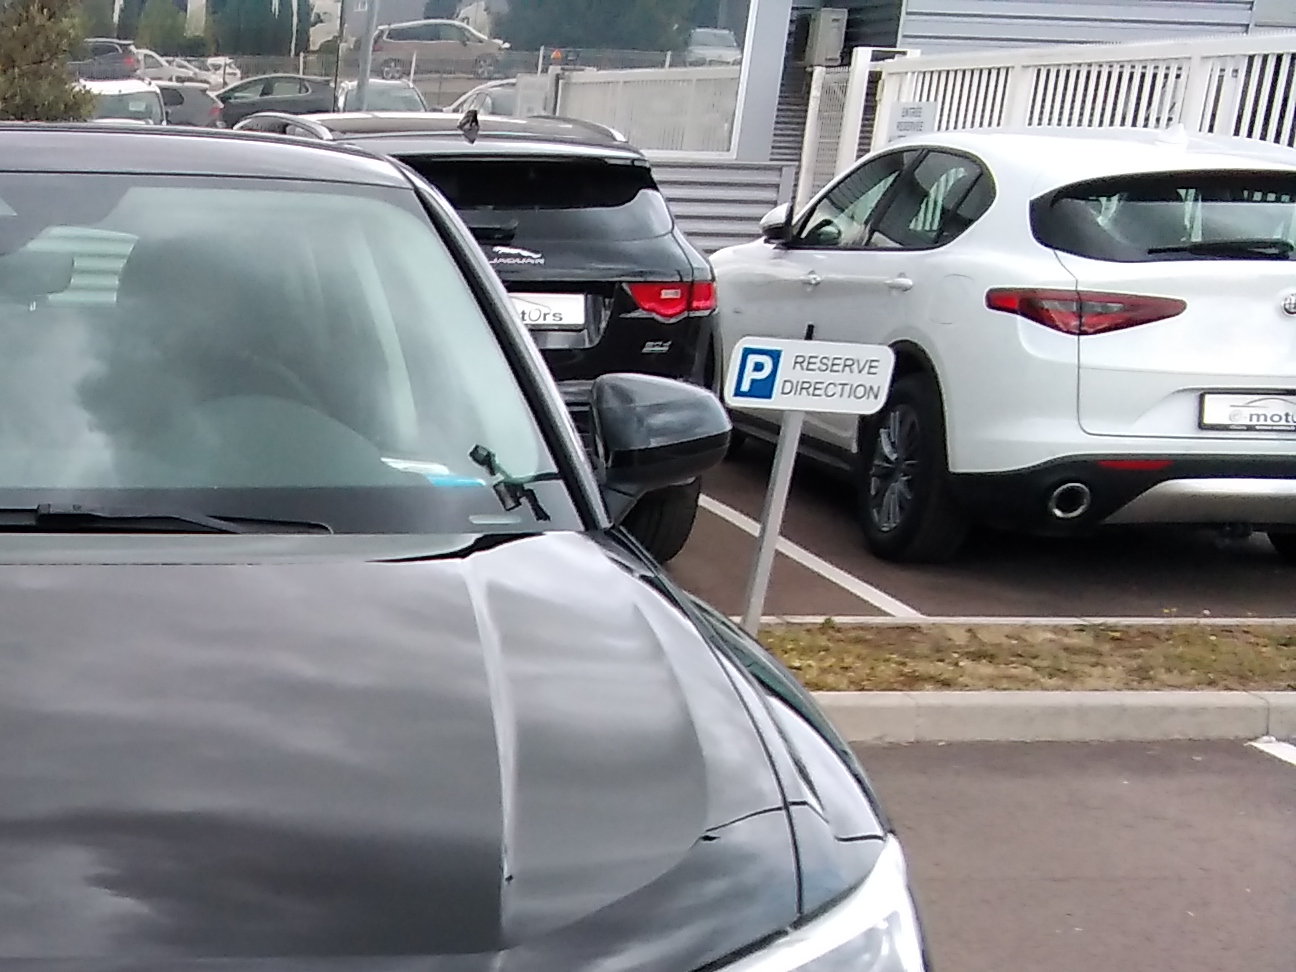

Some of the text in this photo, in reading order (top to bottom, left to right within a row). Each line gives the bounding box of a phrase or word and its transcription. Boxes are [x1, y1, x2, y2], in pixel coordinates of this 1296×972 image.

[520, 308, 563, 322] tors
[740, 354, 773, 393] P
[792, 354, 880, 376] RESERVE
[780, 379, 880, 400] DIRECTION
